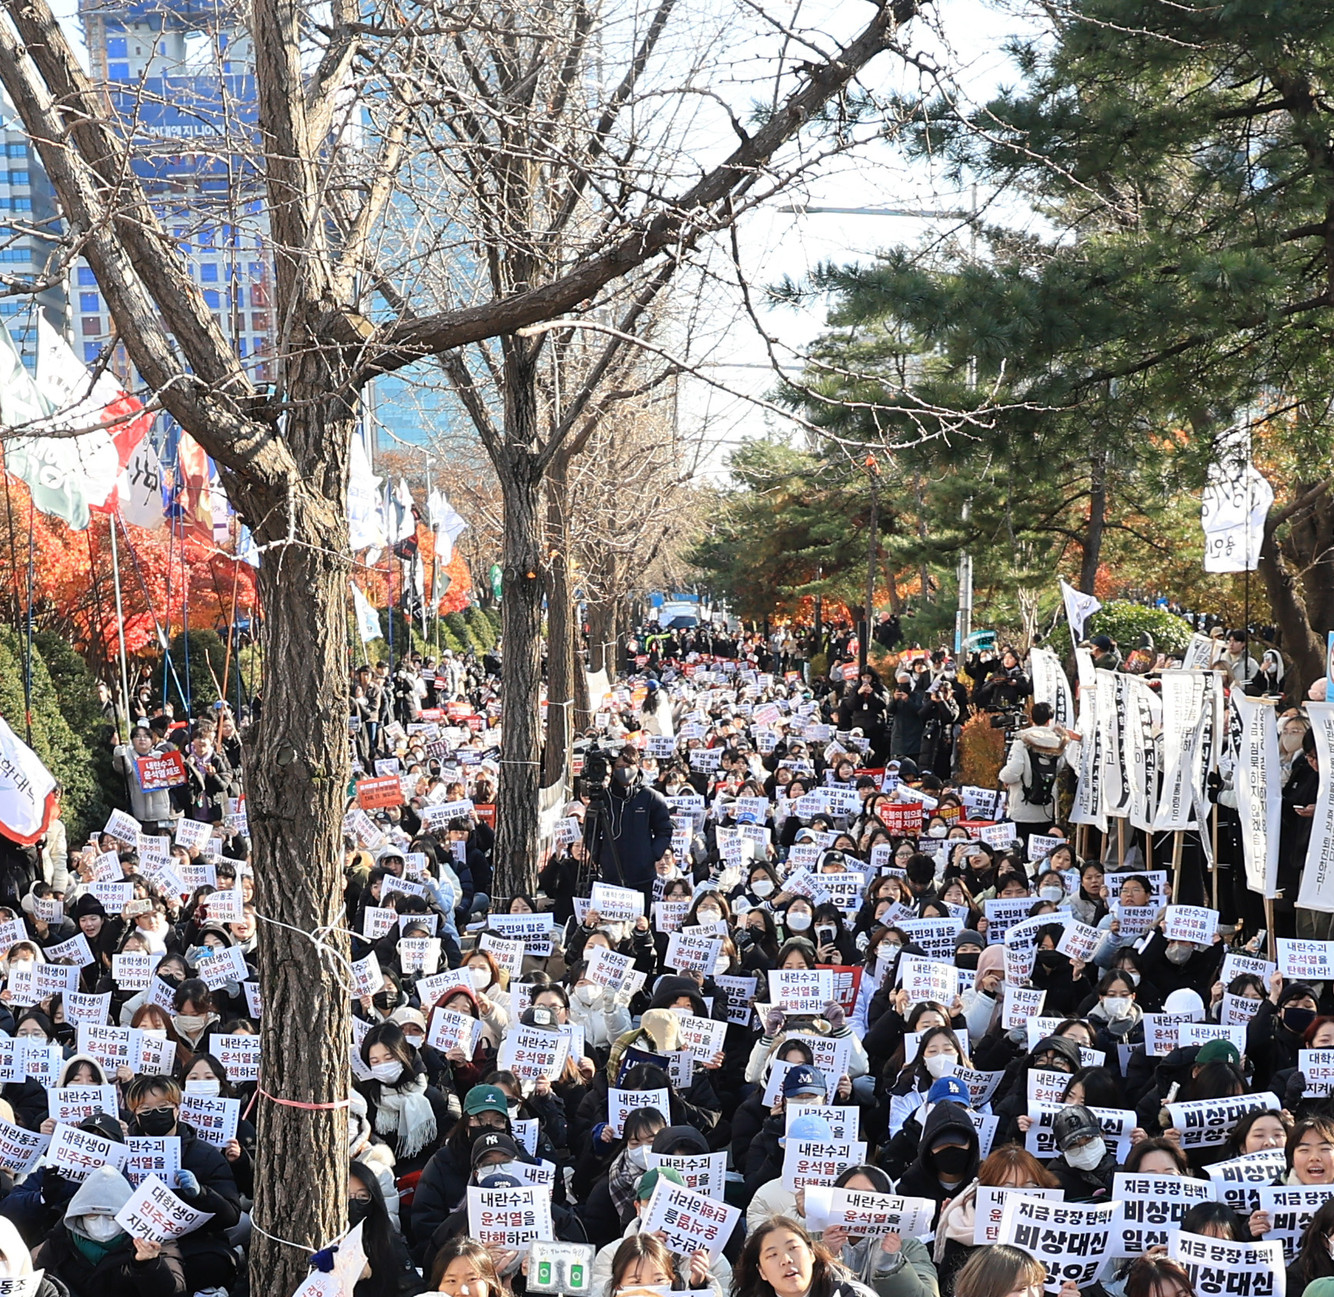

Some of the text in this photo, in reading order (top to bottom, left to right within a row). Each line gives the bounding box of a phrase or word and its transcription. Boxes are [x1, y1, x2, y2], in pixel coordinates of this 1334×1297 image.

[1173, 907, 1208, 920] 내란수괴
[1287, 940, 1327, 953] 내란수괴
[948, 1081, 959, 1093] LA
[1014, 1224, 1109, 1257] 비상대신
